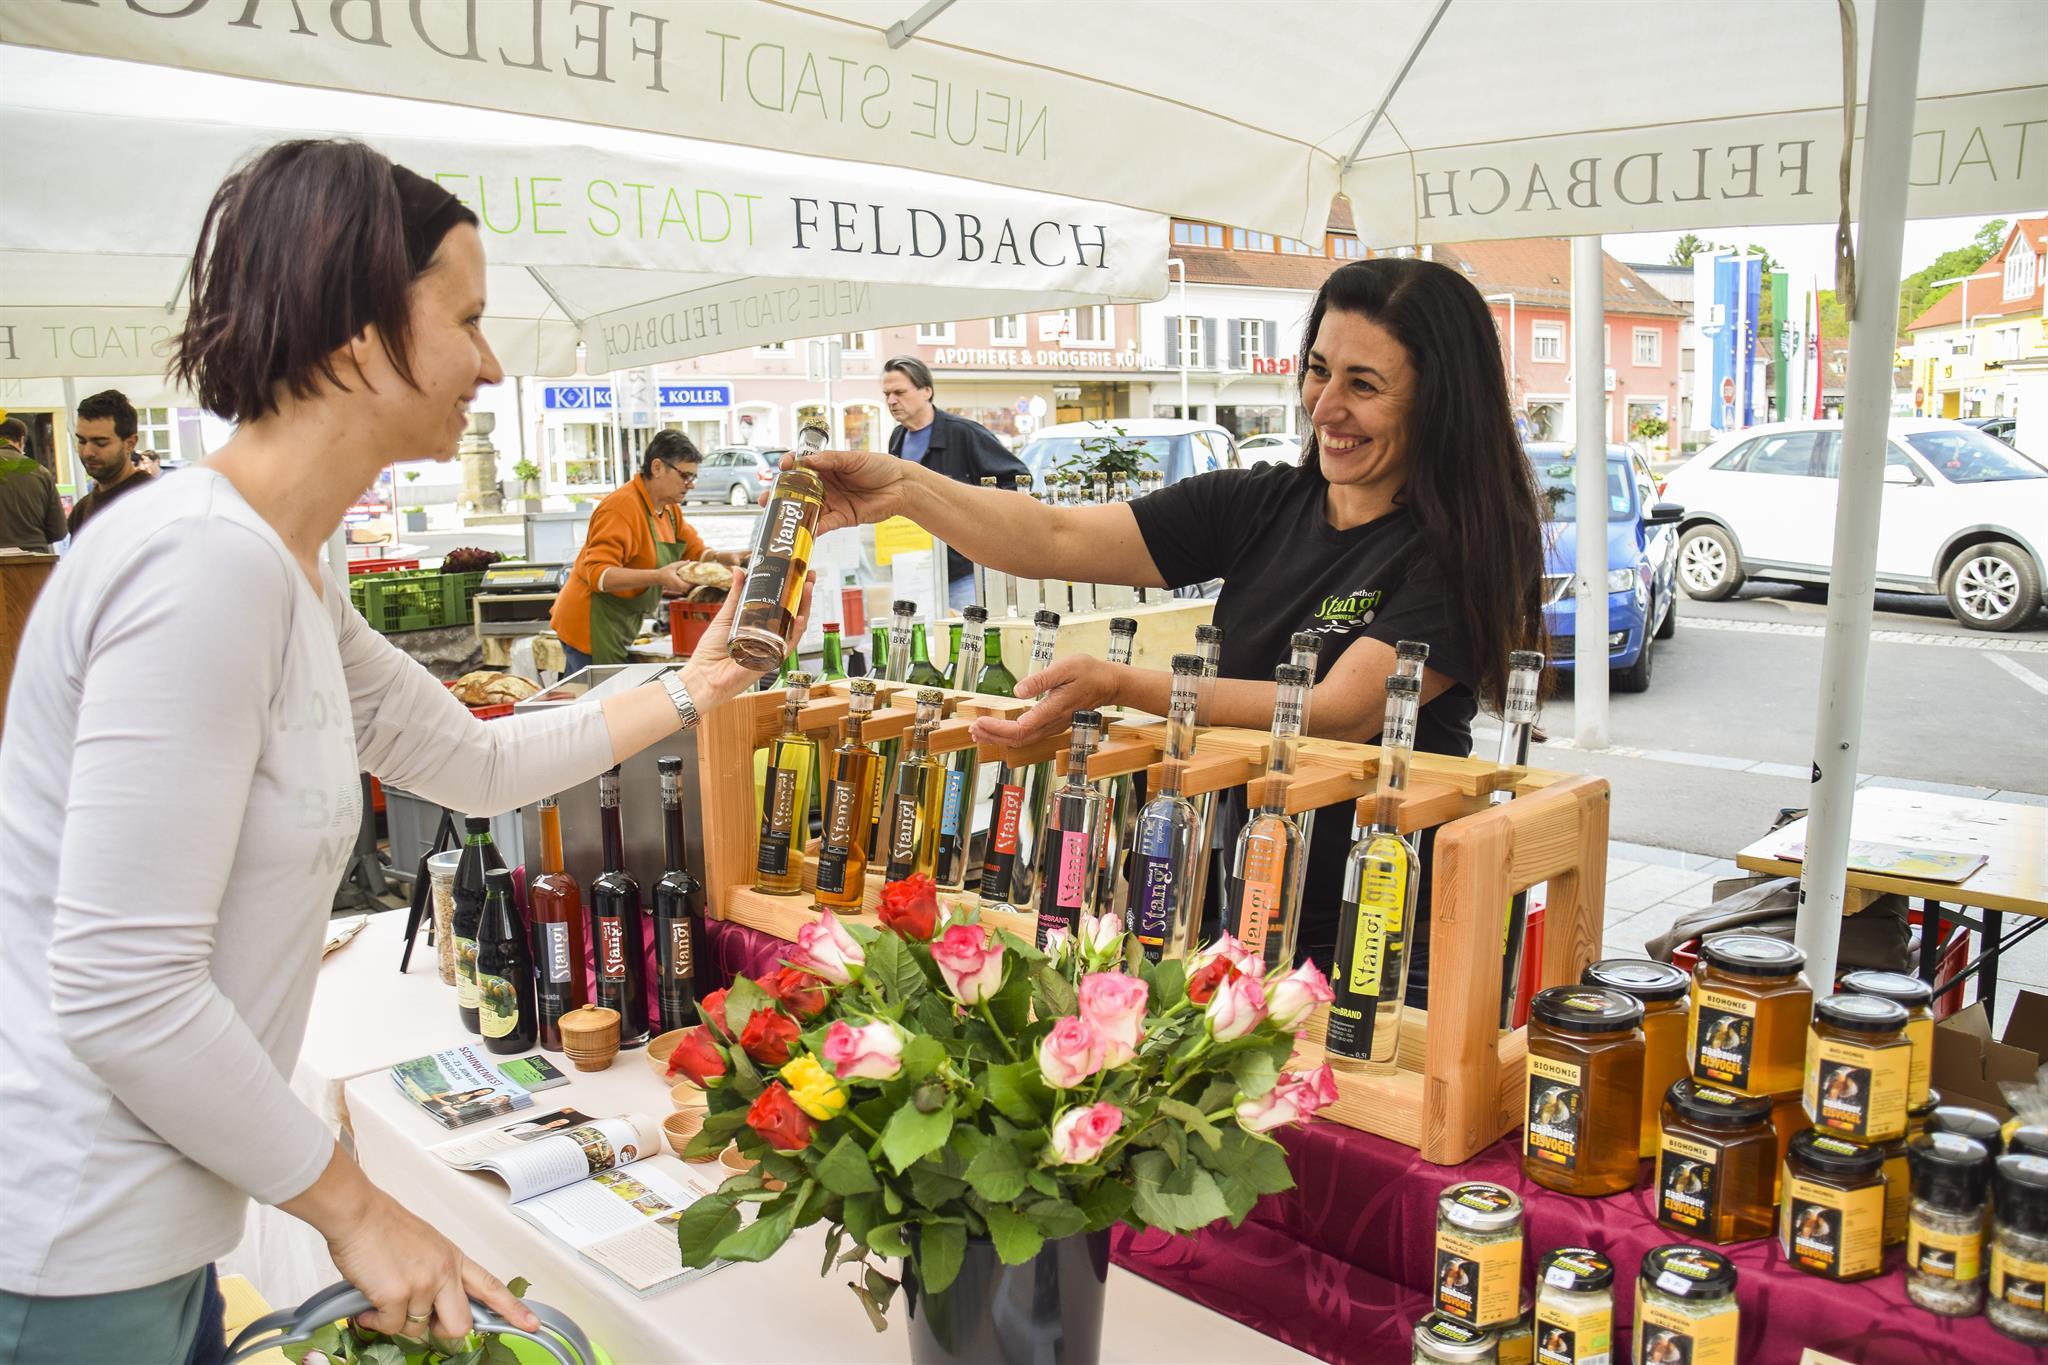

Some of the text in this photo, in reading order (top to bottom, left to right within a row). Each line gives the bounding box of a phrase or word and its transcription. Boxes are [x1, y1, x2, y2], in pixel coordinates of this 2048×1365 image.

[587, 179, 763, 247] STADT
[789, 196, 1111, 270] FELDBACH
[935, 348, 1017, 366] APOTHEKE
[1021, 350, 1033, 364] &
[1037, 350, 1111, 368] DROGERIE
[669, 389, 722, 404] KOLLER
[769, 501, 804, 557] Stangl
[1314, 590, 1382, 618] Stangl
[831, 785, 857, 843] Stangl
[894, 800, 916, 860] Stangl
[996, 790, 1023, 848] Stangl
[1142, 862, 1173, 932] Stangl
[551, 926, 569, 980] Stangl
[603, 920, 626, 974] Stangl
[672, 922, 693, 976] Stangl
[1354, 911, 1385, 993] Stangl
[1707, 995, 1748, 1010] BIOHONIG
[436, 1053, 463, 1081] AUERSBACH
[459, 1046, 505, 1087] SCHINKENFEST
[1533, 1060, 1578, 1079] BIOHONIG
[1700, 1054, 1743, 1075] EISVOGEL
[1529, 1132, 1576, 1157] EISVOGEL
[1668, 1139, 1708, 1157] BIOHONIG
[1664, 1198, 1706, 1220] EISVOGEL
